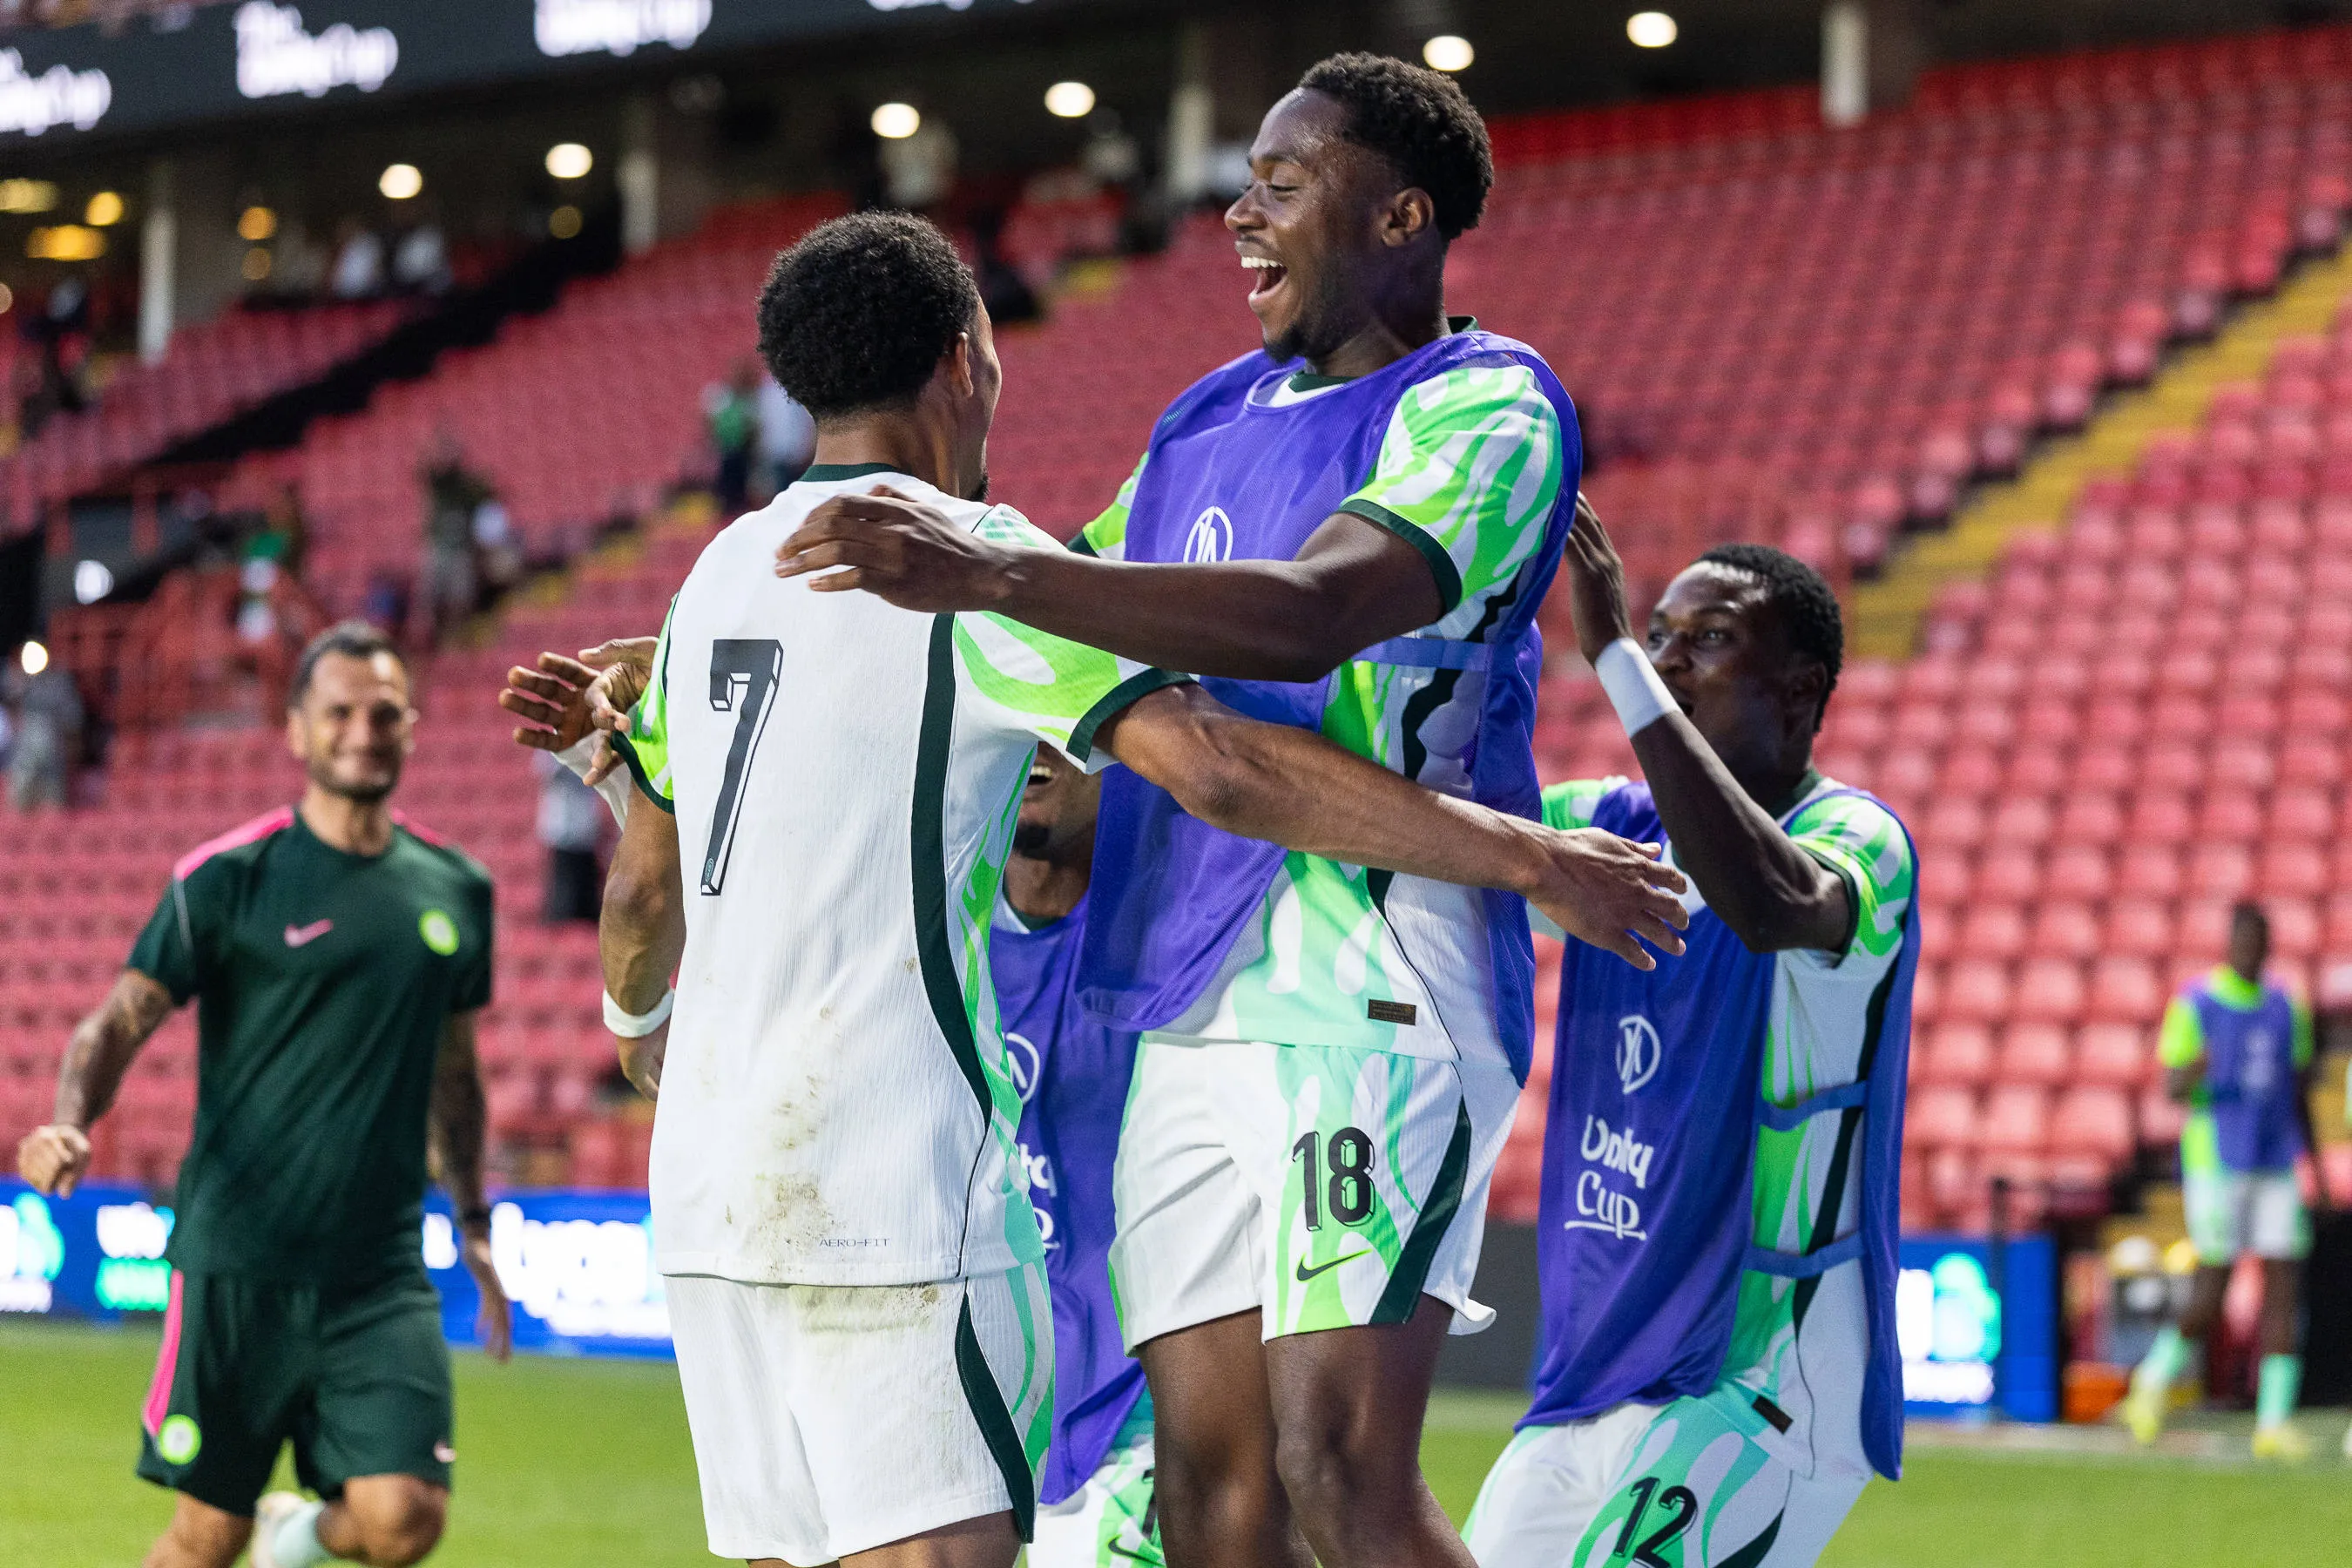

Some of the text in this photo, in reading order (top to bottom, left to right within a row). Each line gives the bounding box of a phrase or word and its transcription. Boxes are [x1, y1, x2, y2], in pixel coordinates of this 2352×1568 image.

[700, 639, 783, 896] 7
[1292, 1126, 1375, 1231] 18
[1580, 1114, 1654, 1189] Unty
[819, 1238, 890, 1247] AERO-FIT
[1577, 1170, 1639, 1240] Cup
[1613, 1477, 1699, 1568] 12
